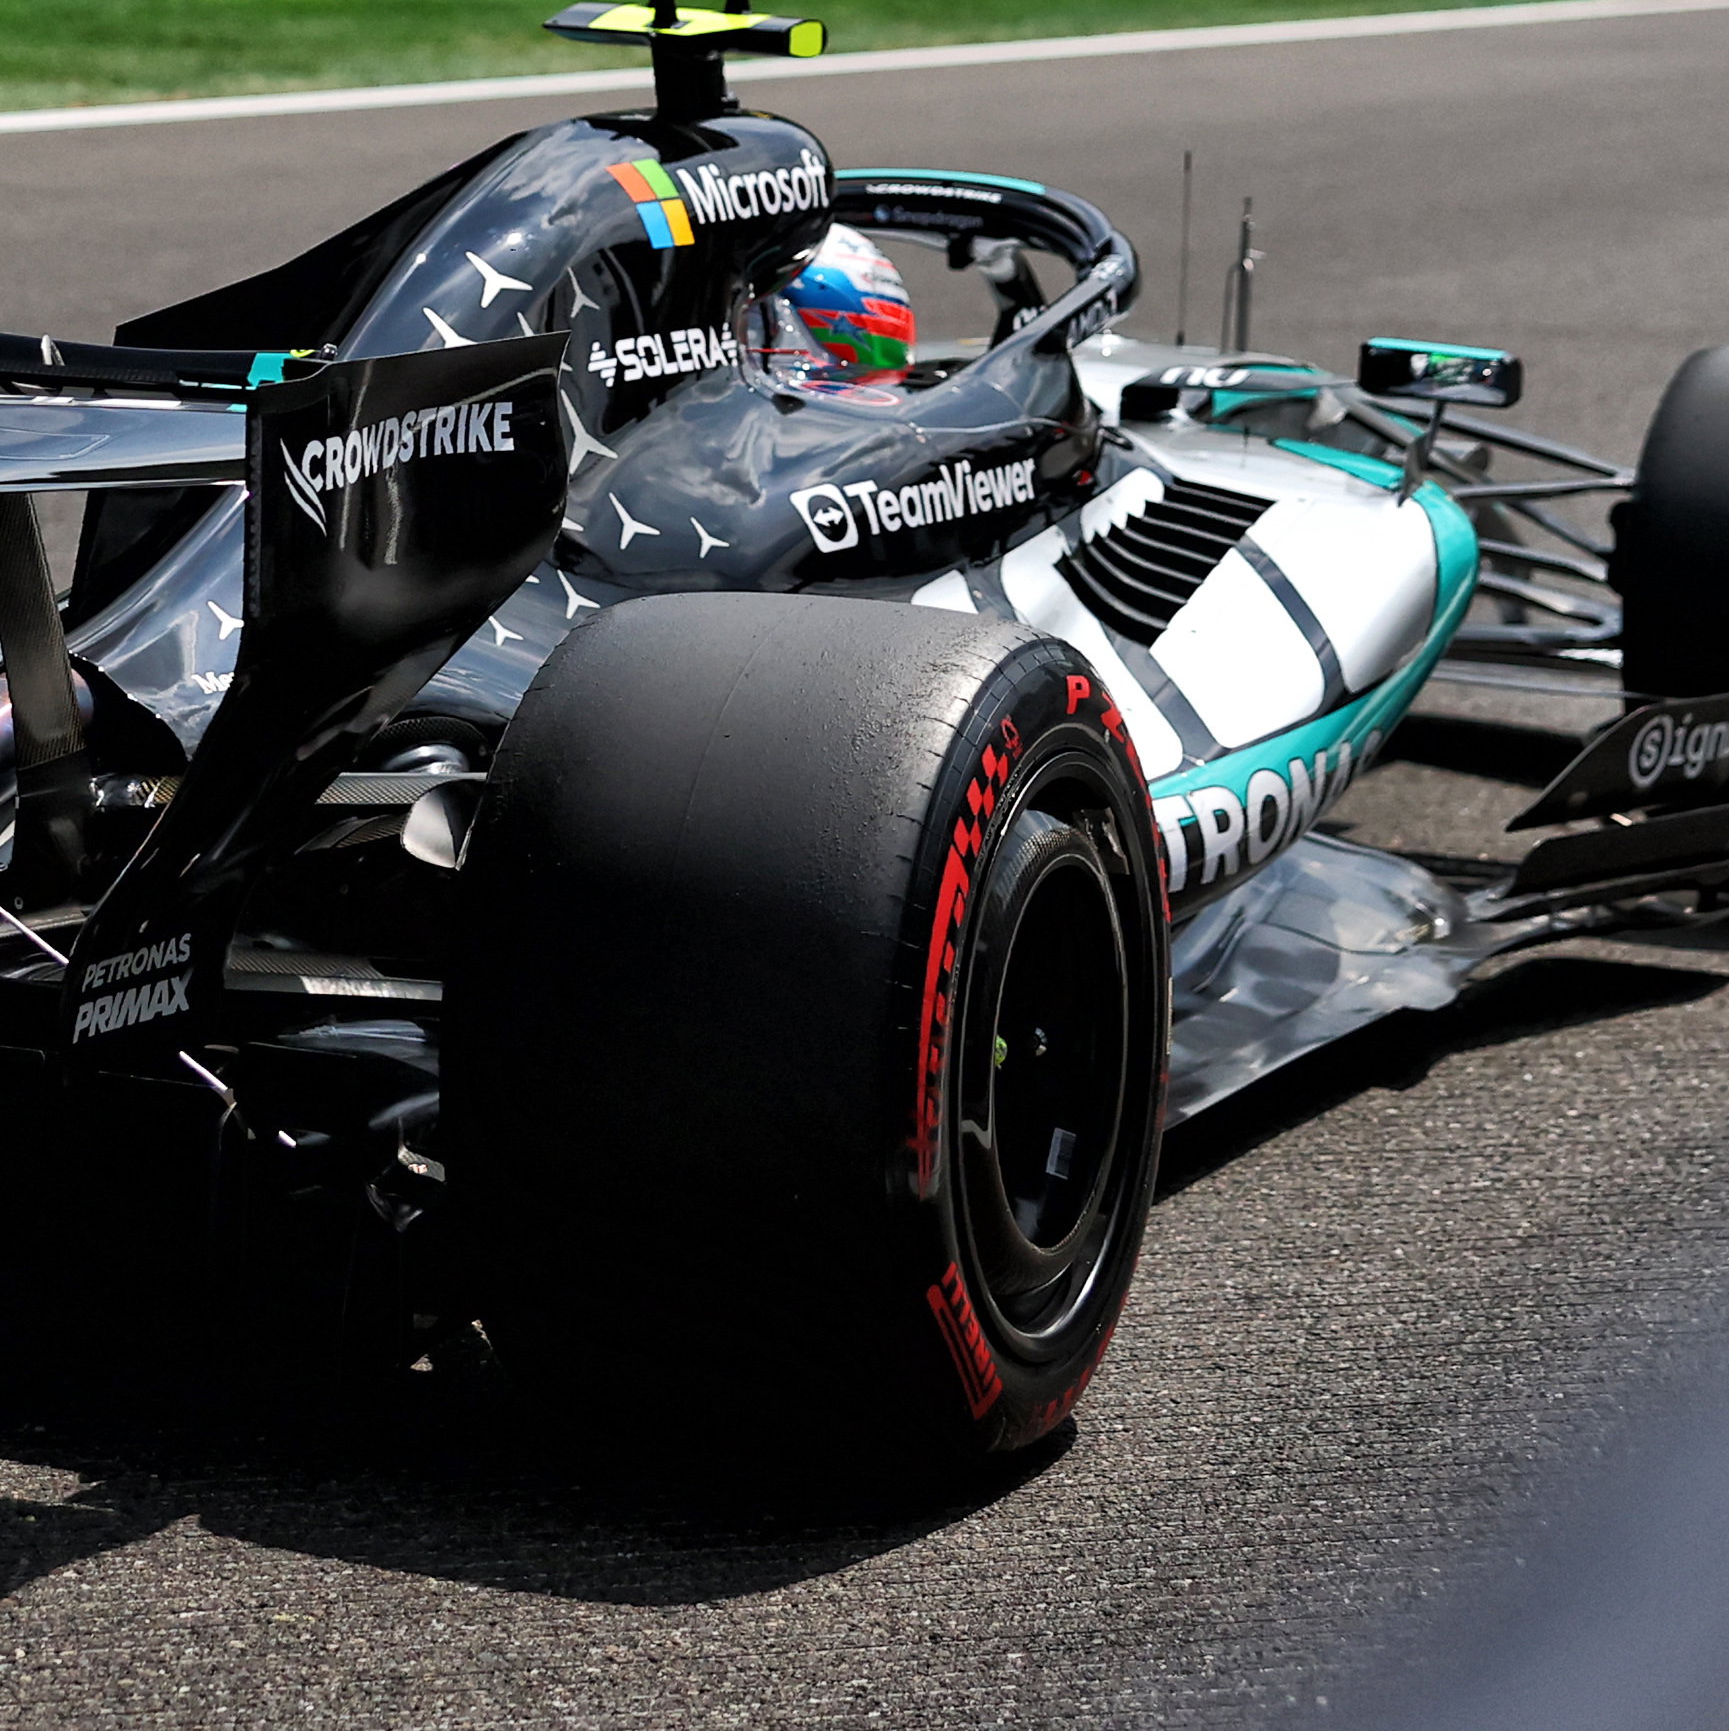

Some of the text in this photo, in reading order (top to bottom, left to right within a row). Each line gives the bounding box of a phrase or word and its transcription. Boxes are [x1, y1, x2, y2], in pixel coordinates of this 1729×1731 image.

[677, 148, 830, 224] Microsoft
[614, 327, 720, 382] SOLERA
[302, 401, 516, 493] CROWDSTRIKE
[856, 457, 1037, 535] TeamViewer
[81, 933, 192, 993] PETRONAS
[72, 972, 192, 1045] PRIMAX
